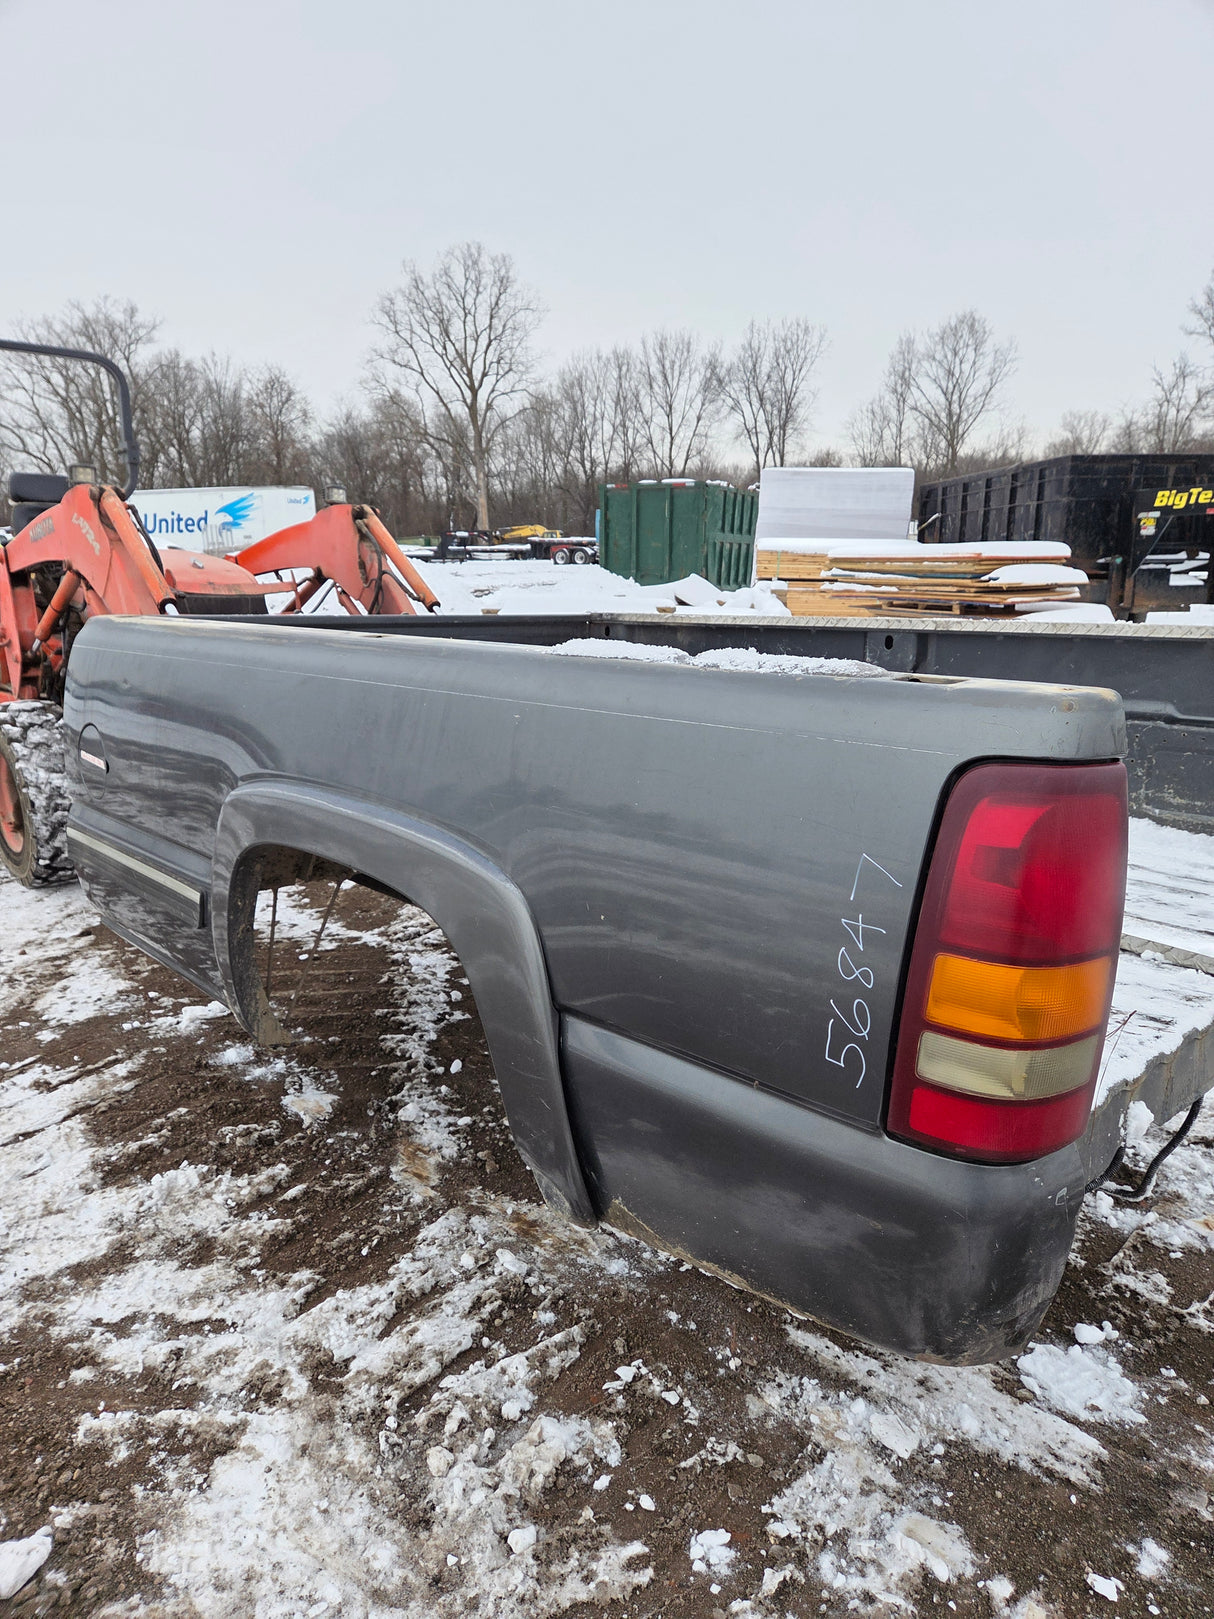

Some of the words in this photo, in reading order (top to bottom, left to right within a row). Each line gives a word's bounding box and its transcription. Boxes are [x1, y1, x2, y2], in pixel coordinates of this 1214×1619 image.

[1153, 487, 1214, 509] BigTe
[144, 509, 208, 534] United
[825, 853, 903, 1089] 56847
